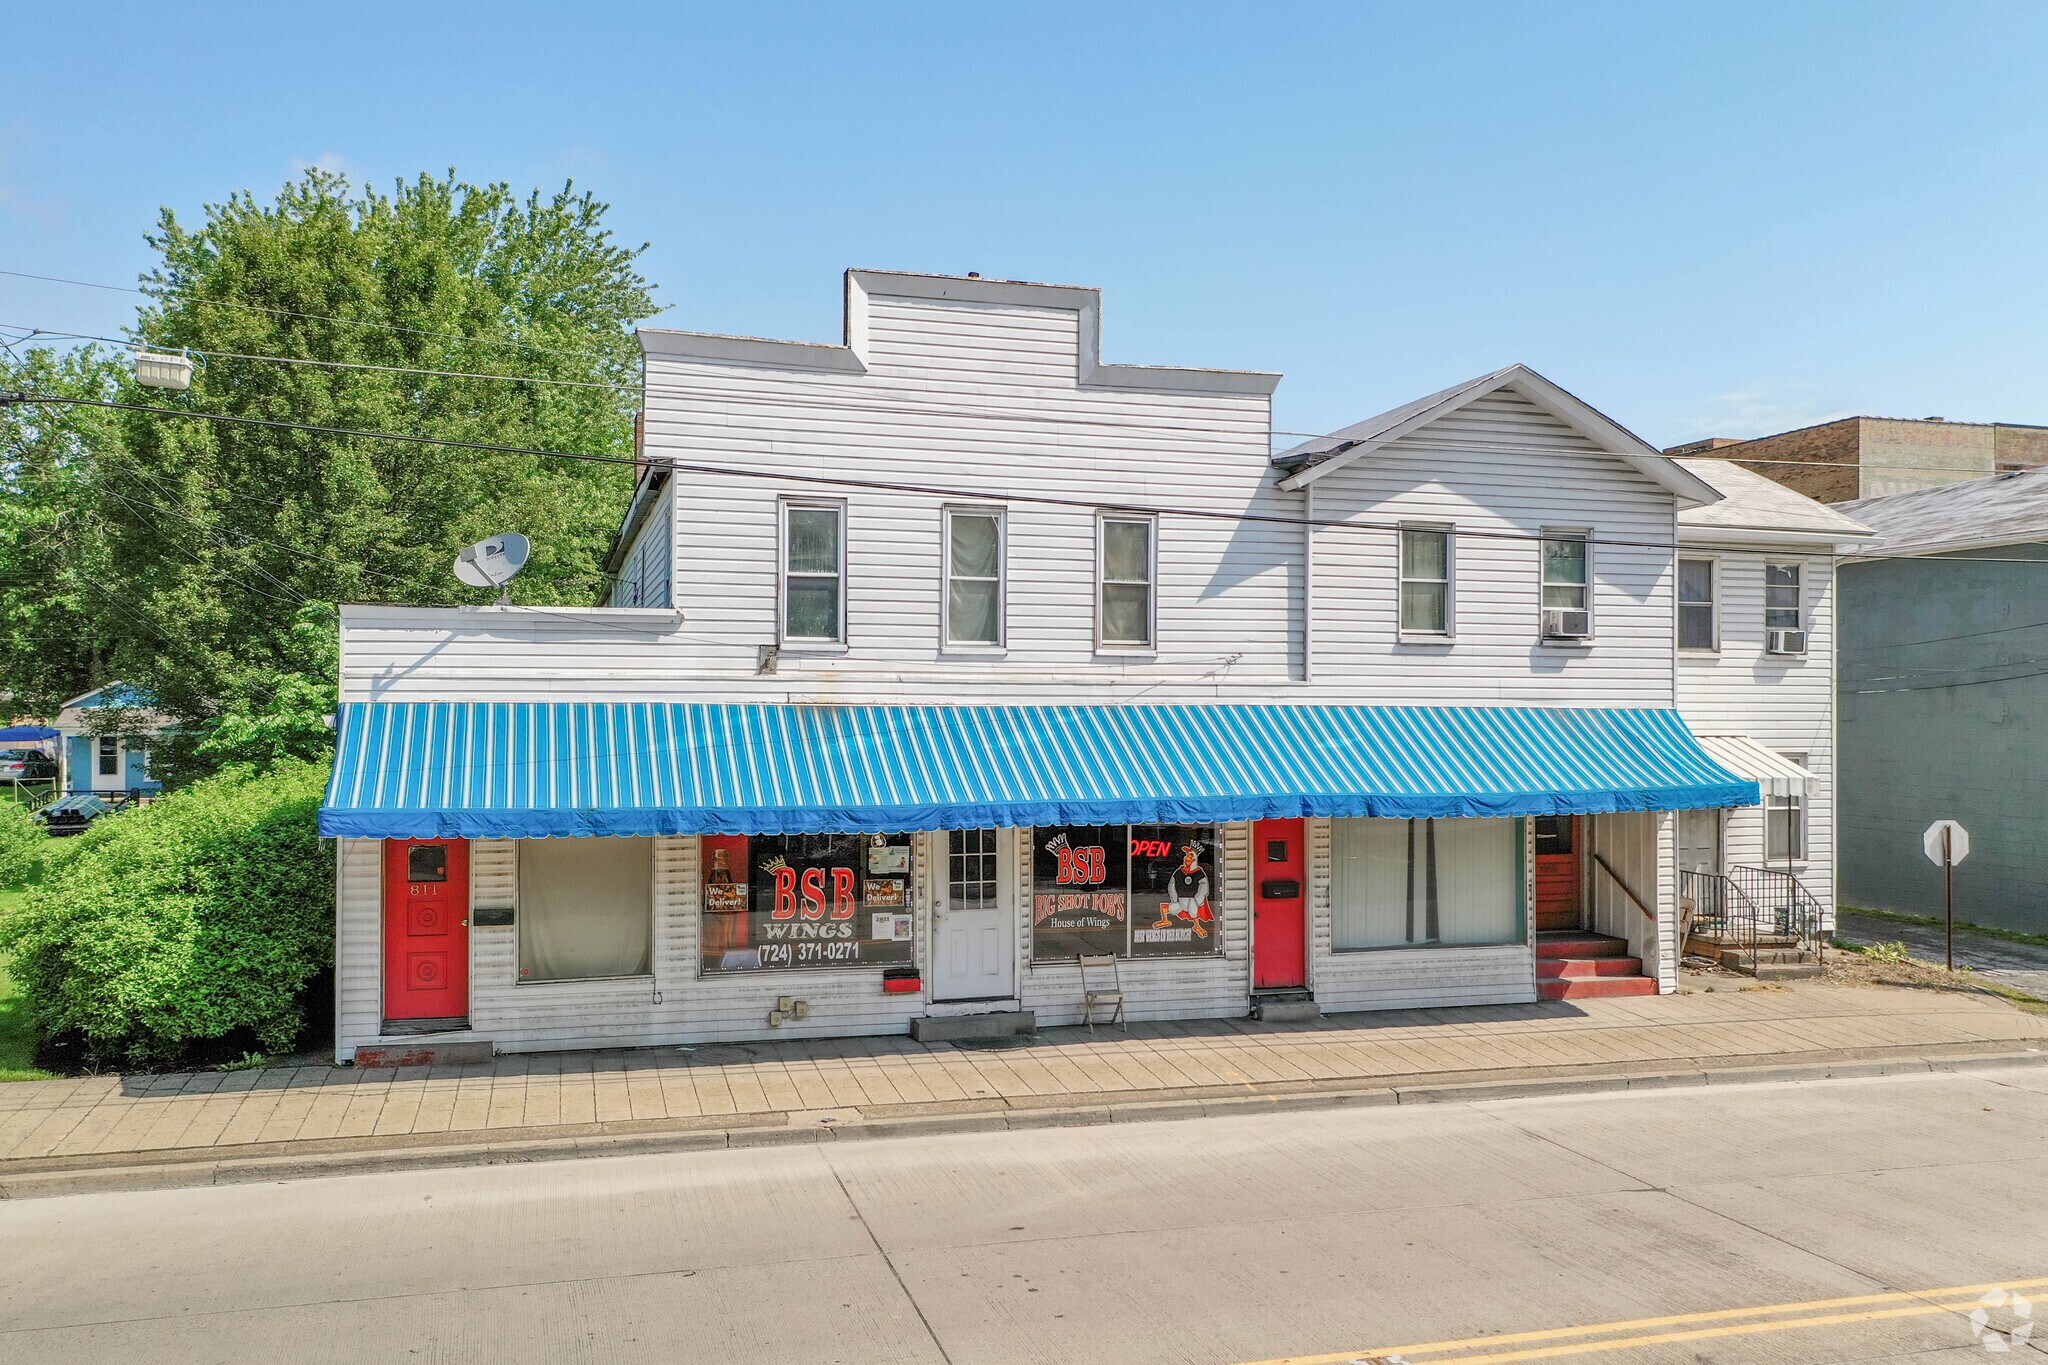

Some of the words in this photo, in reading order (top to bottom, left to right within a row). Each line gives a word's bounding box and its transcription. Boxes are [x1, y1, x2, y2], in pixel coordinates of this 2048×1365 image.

[1130, 840, 1173, 857] OPEN
[1056, 846, 1106, 884] BSB
[411, 884, 437, 896] 811
[772, 867, 855, 920] BSB
[867, 882, 880, 891] We
[709, 898, 741, 906] Deliver!
[867, 893, 897, 901] Deliver!
[1035, 895, 1056, 926] BIG
[1058, 894, 1090, 911] SHOT
[1092, 893, 1124, 921] BOB'S
[1051, 917, 1075, 928] House
[1077, 916, 1085, 927] of
[1087, 916, 1110, 929] Wings
[763, 923, 852, 939] WINGS
[758, 943, 792, 967] (724)
[798, 942, 859, 960] 371-0271
